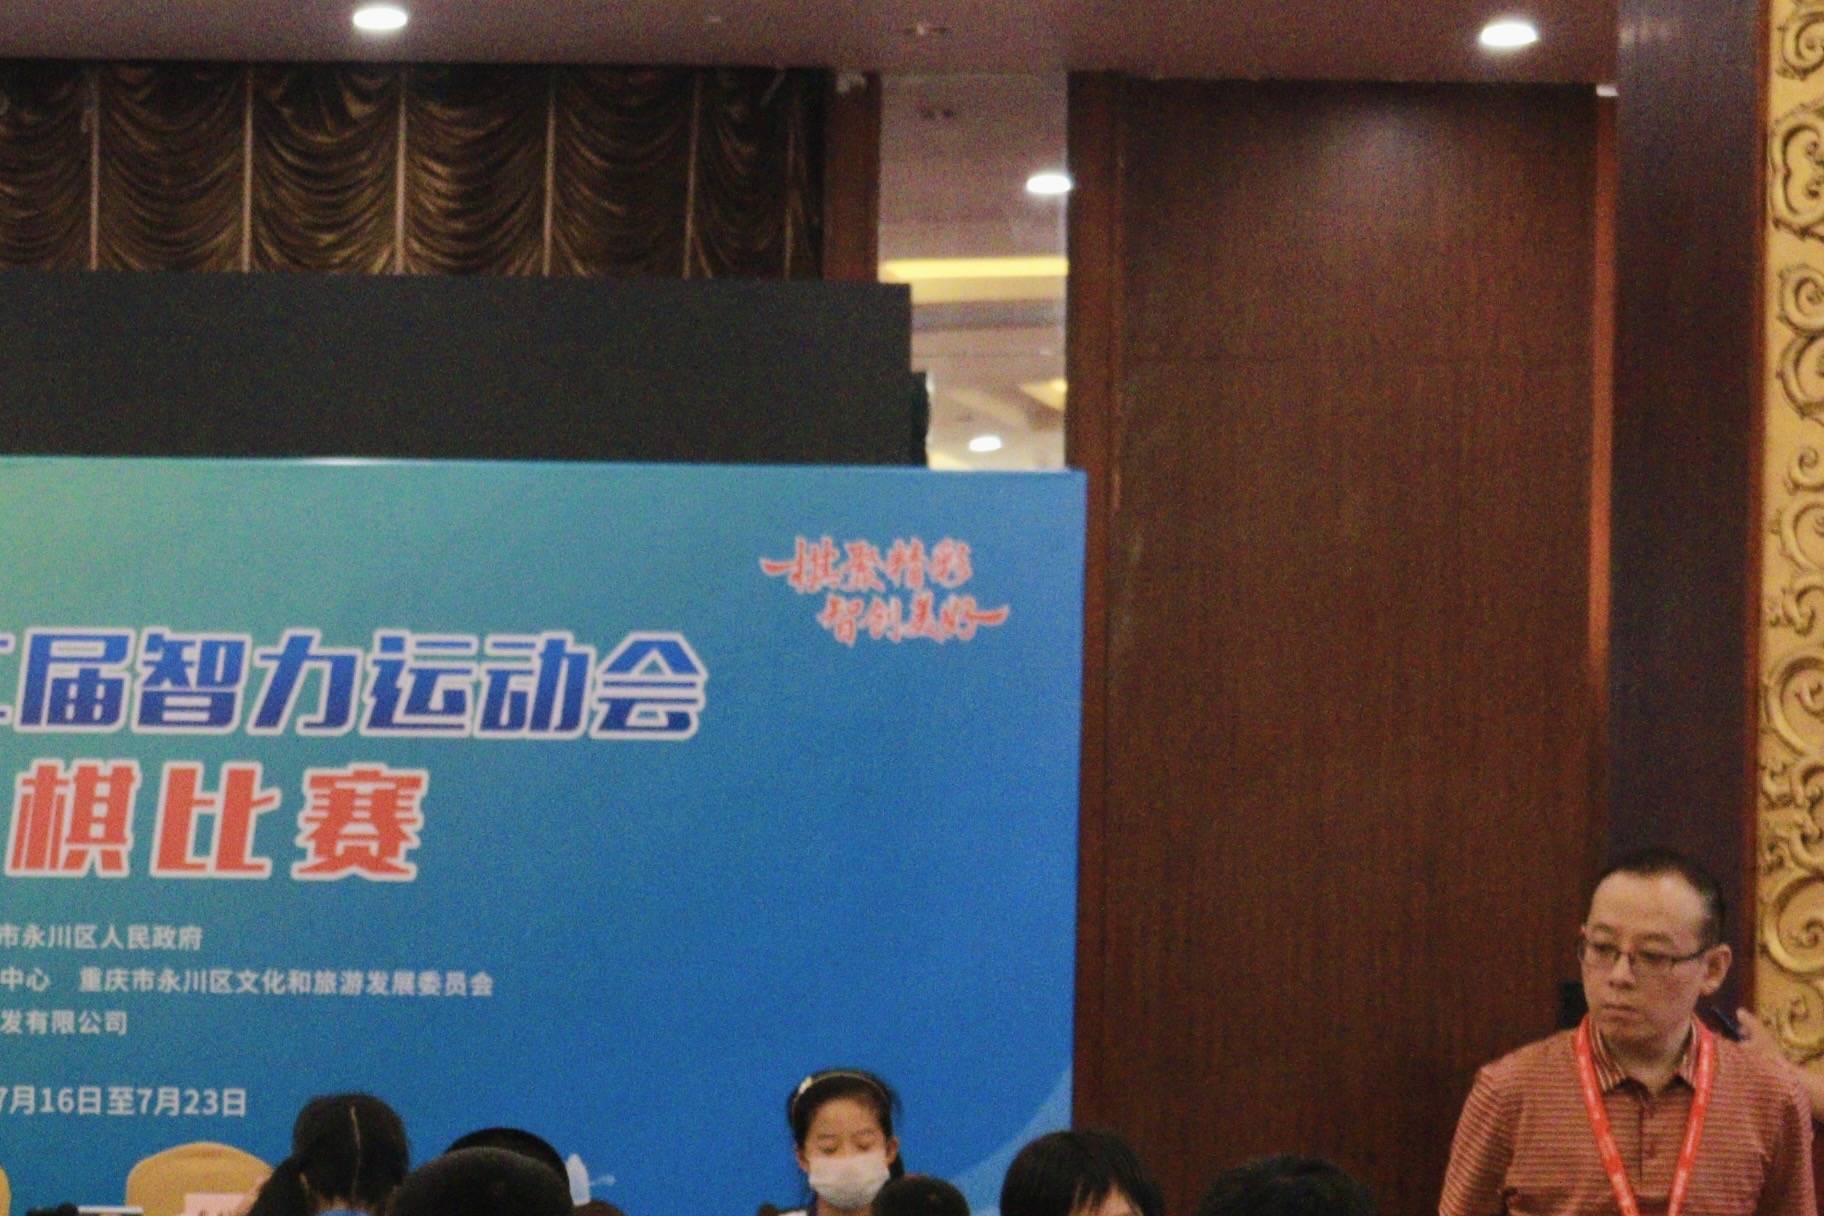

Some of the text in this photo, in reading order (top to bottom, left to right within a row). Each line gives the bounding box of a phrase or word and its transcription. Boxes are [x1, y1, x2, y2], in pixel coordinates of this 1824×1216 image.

[79, 966, 493, 997] 重庆市永川区文化和旅游发展委员会
